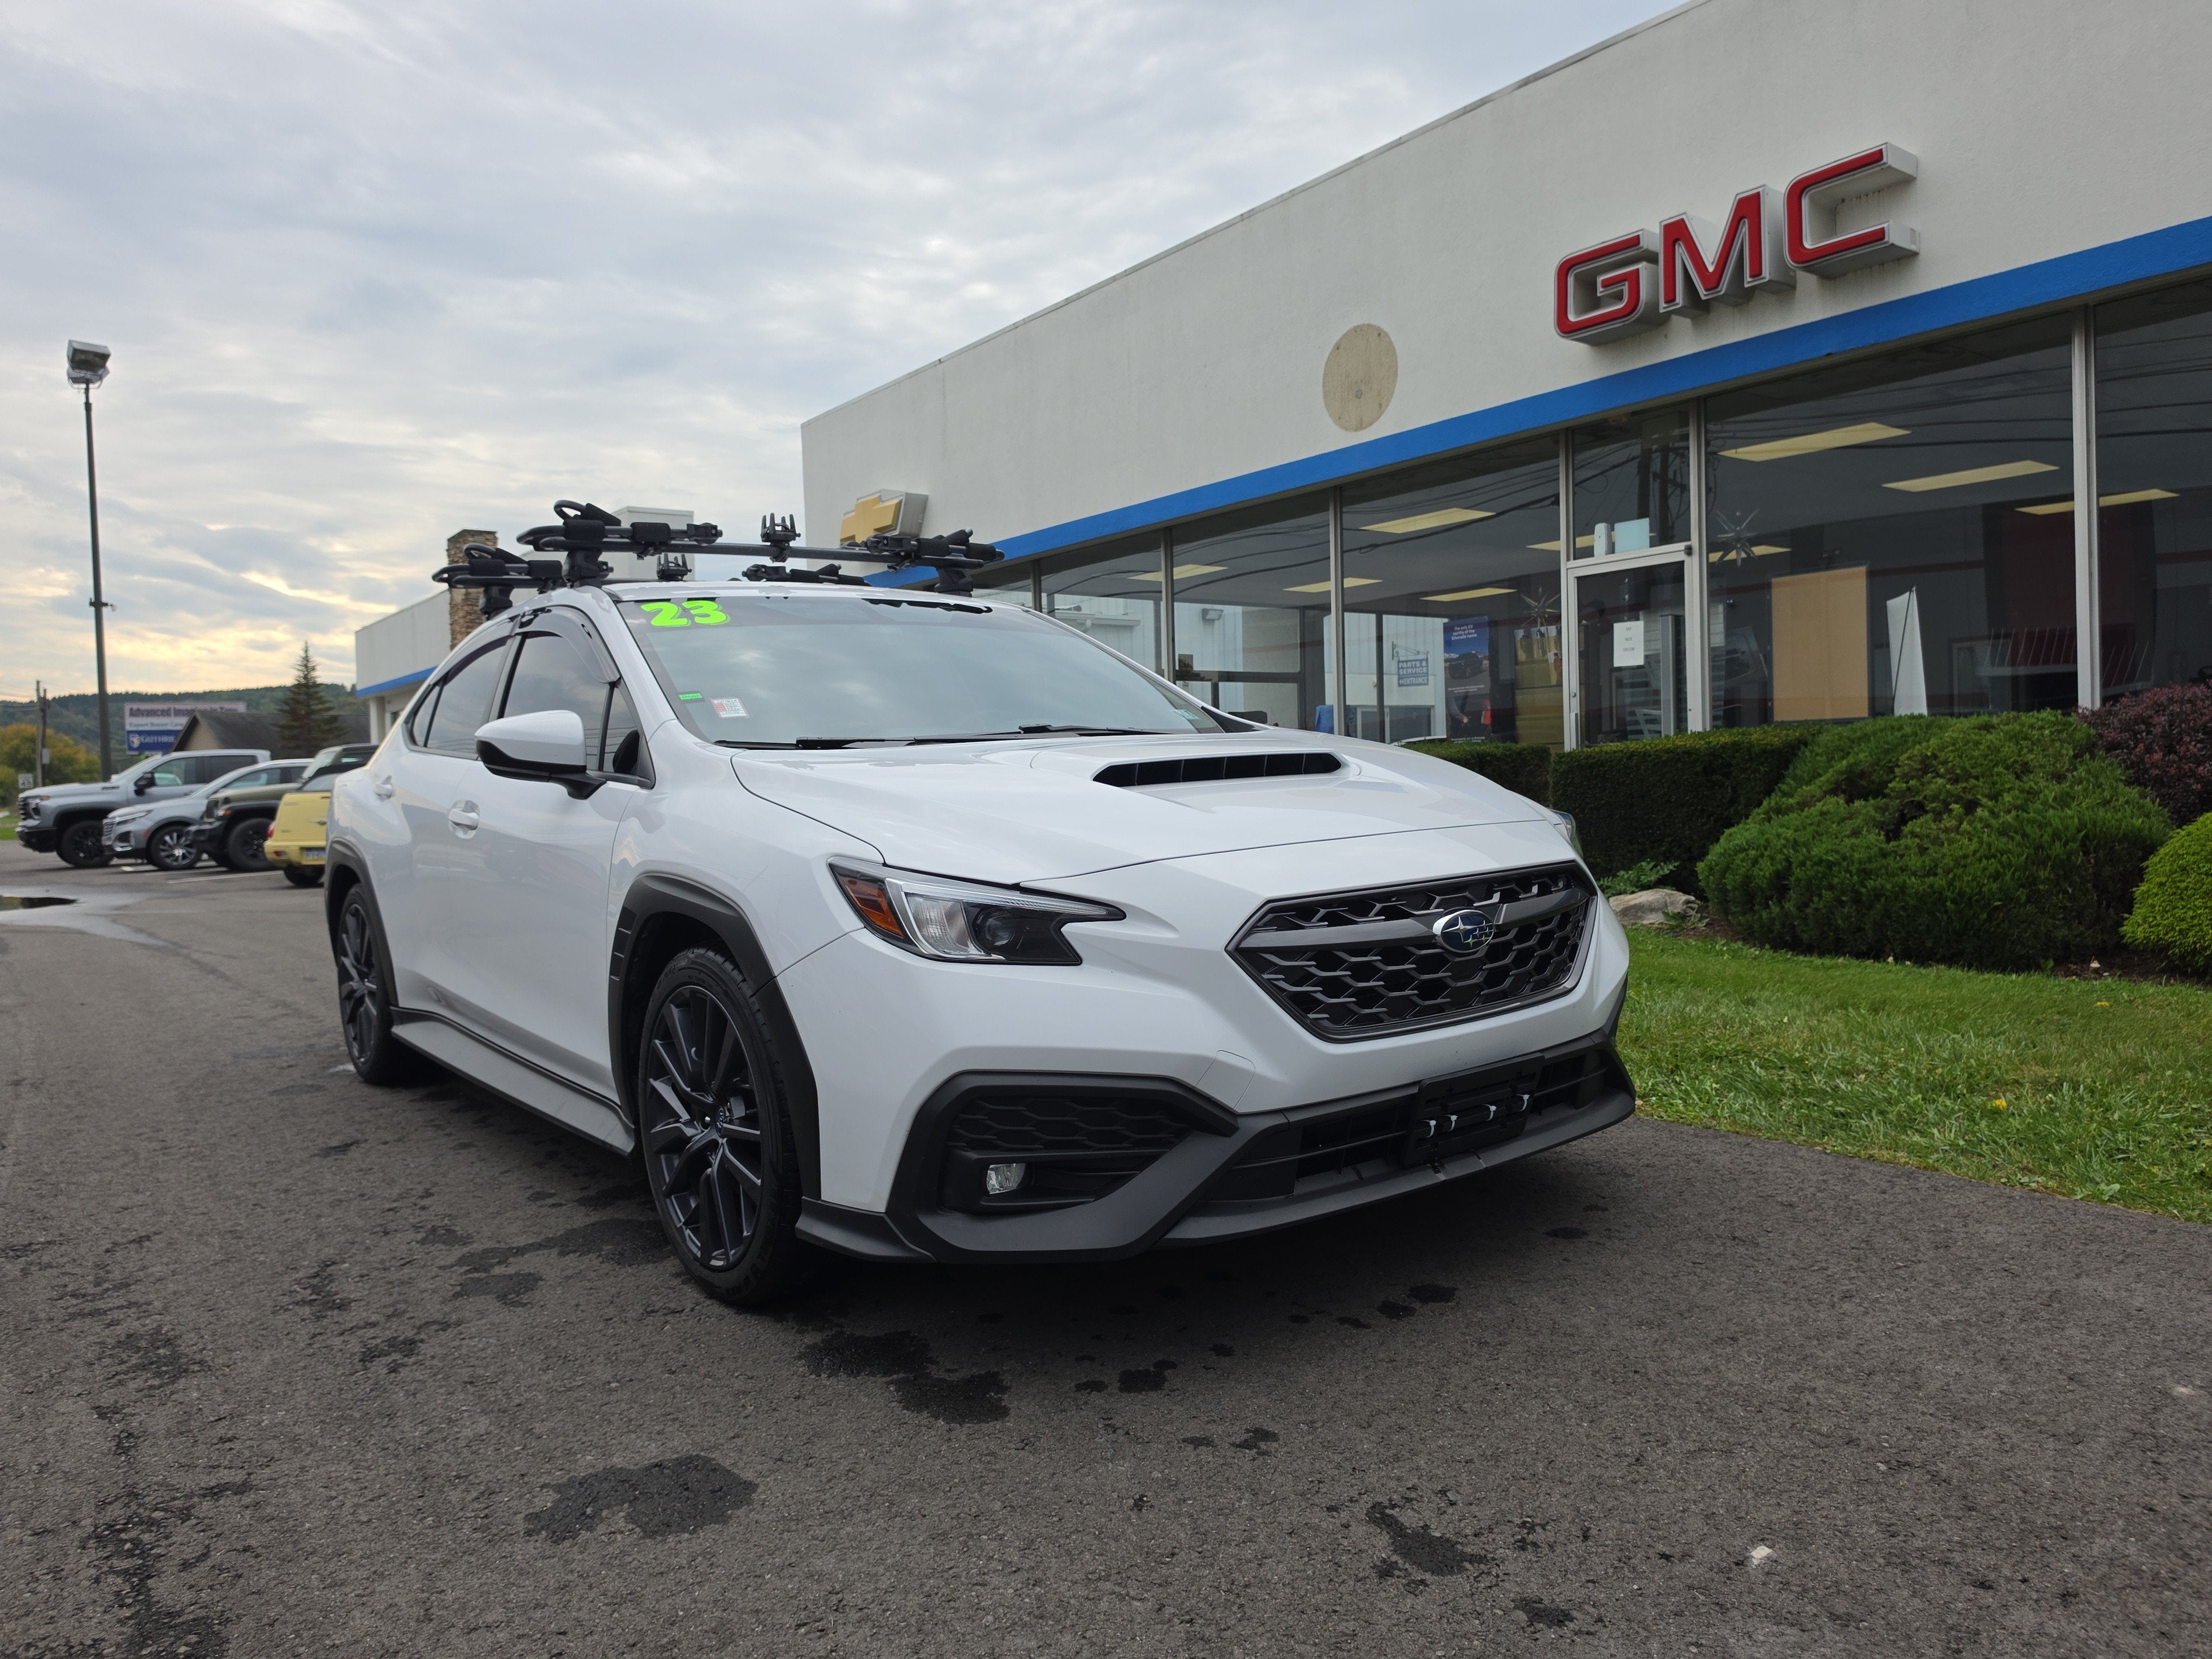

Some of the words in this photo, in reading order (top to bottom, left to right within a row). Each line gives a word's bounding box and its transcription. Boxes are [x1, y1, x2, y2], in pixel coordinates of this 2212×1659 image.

[1554, 142, 1917, 344] GMC
[641, 600, 730, 626] 23
[1399, 667, 1427, 675] SERVICE
[1404, 677, 1427, 685] ENTRANCE
[129, 707, 171, 717] Advanced
